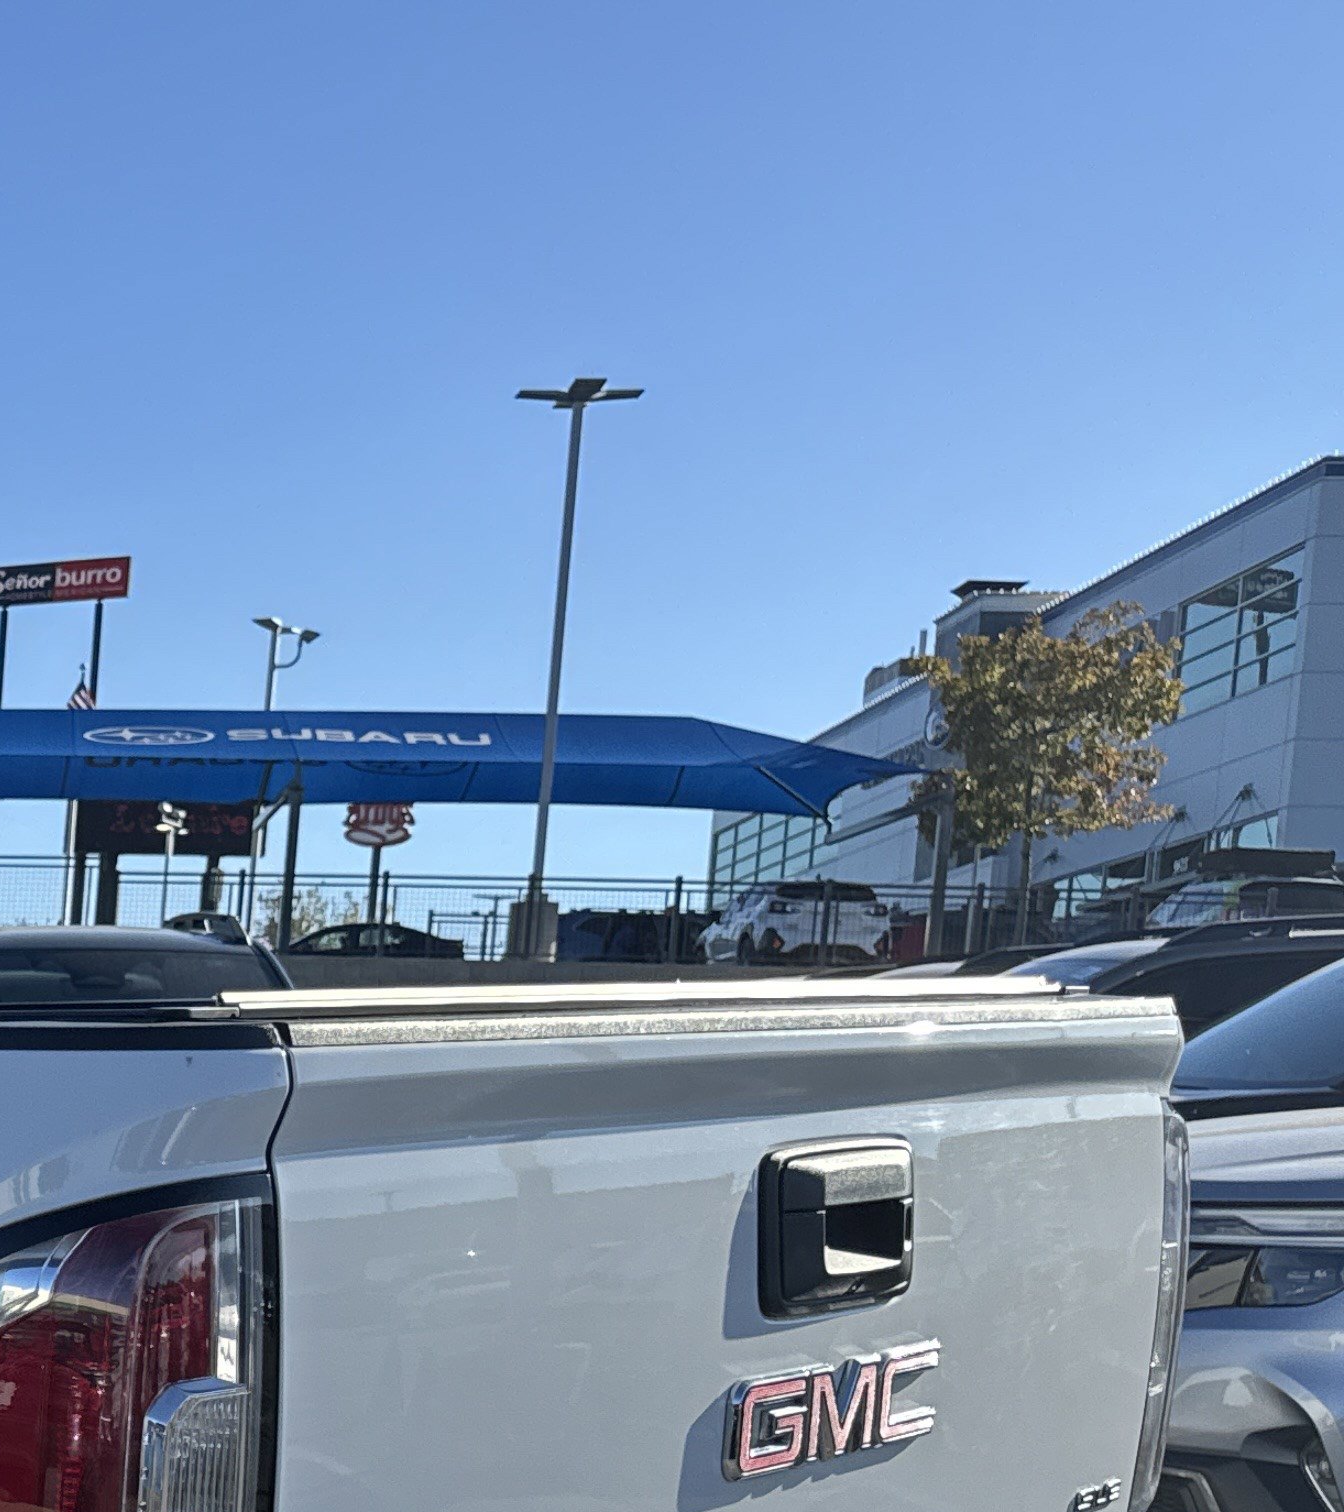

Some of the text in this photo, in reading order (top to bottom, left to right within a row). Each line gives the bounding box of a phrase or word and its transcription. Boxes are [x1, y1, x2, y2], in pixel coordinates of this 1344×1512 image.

[54, 567, 122, 587] burro
[226, 728, 491, 746] SUBARU
[721, 1338, 941, 1482] GMC
